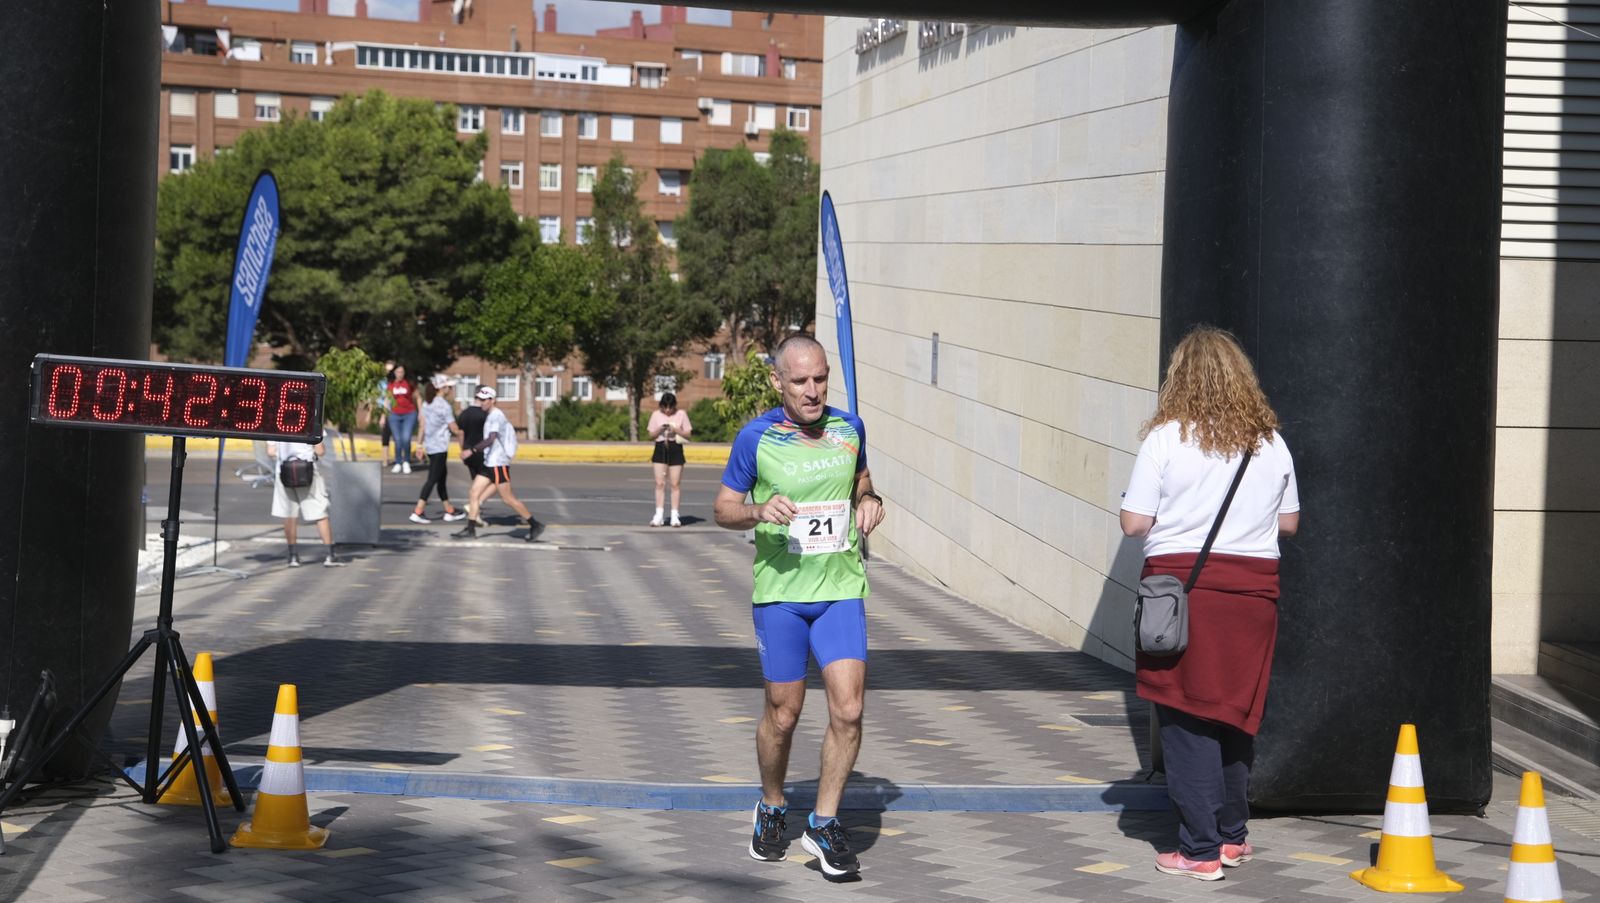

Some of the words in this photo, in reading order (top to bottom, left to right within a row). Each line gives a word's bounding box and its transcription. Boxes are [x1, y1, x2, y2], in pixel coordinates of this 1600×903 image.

[49, 365, 308, 433] 00:42:36
[802, 455, 852, 472] SAKATA
[809, 517, 833, 536] 21
